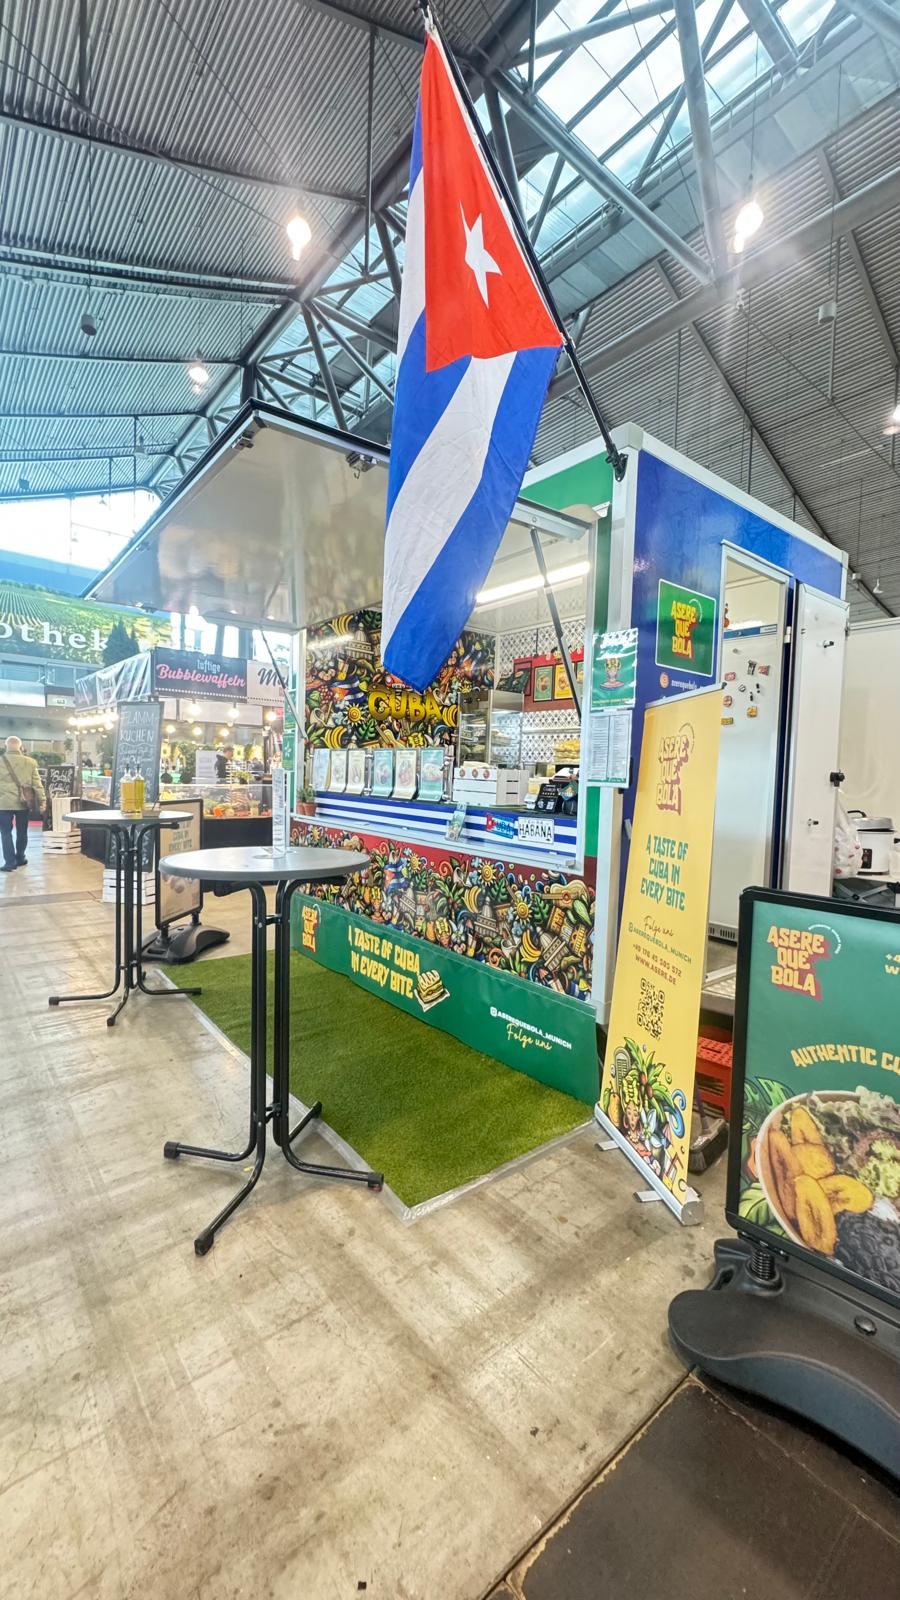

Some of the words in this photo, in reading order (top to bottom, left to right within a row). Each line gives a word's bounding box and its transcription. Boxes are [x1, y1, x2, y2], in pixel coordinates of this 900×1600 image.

[671, 600, 697, 623] ASERE
[675, 619, 690, 638] QUE
[672, 635, 692, 659] BOLA
[156, 663, 246, 688] Bubblewaffeln
[368, 687, 443, 721] CUBA
[519, 822, 553, 838] HABANA
[646, 834, 651, 854] A
[654, 835, 676, 858] TASTE
[677, 841, 688, 861] OF
[649, 858, 668, 884] CUBA
[672, 864, 680, 886] IN
[640, 877, 664, 904] EVERY
[666, 887, 685, 911] BITE
[354, 927, 380, 955] TASTE
[381, 939, 393, 960] OF
[394, 944, 420, 976] CUBA
[767, 925, 825, 955] ASERE
[777, 946, 811, 970] QUE
[351, 950, 360, 972] IN
[360, 955, 389, 987] EVERY
[390, 970, 413, 999] BITE
[771, 965, 816, 997] BOLA
[506, 1023, 534, 1049] Folge
[535, 1039, 553, 1051] uns
[790, 1043, 878, 1068] AUTHENTIC
